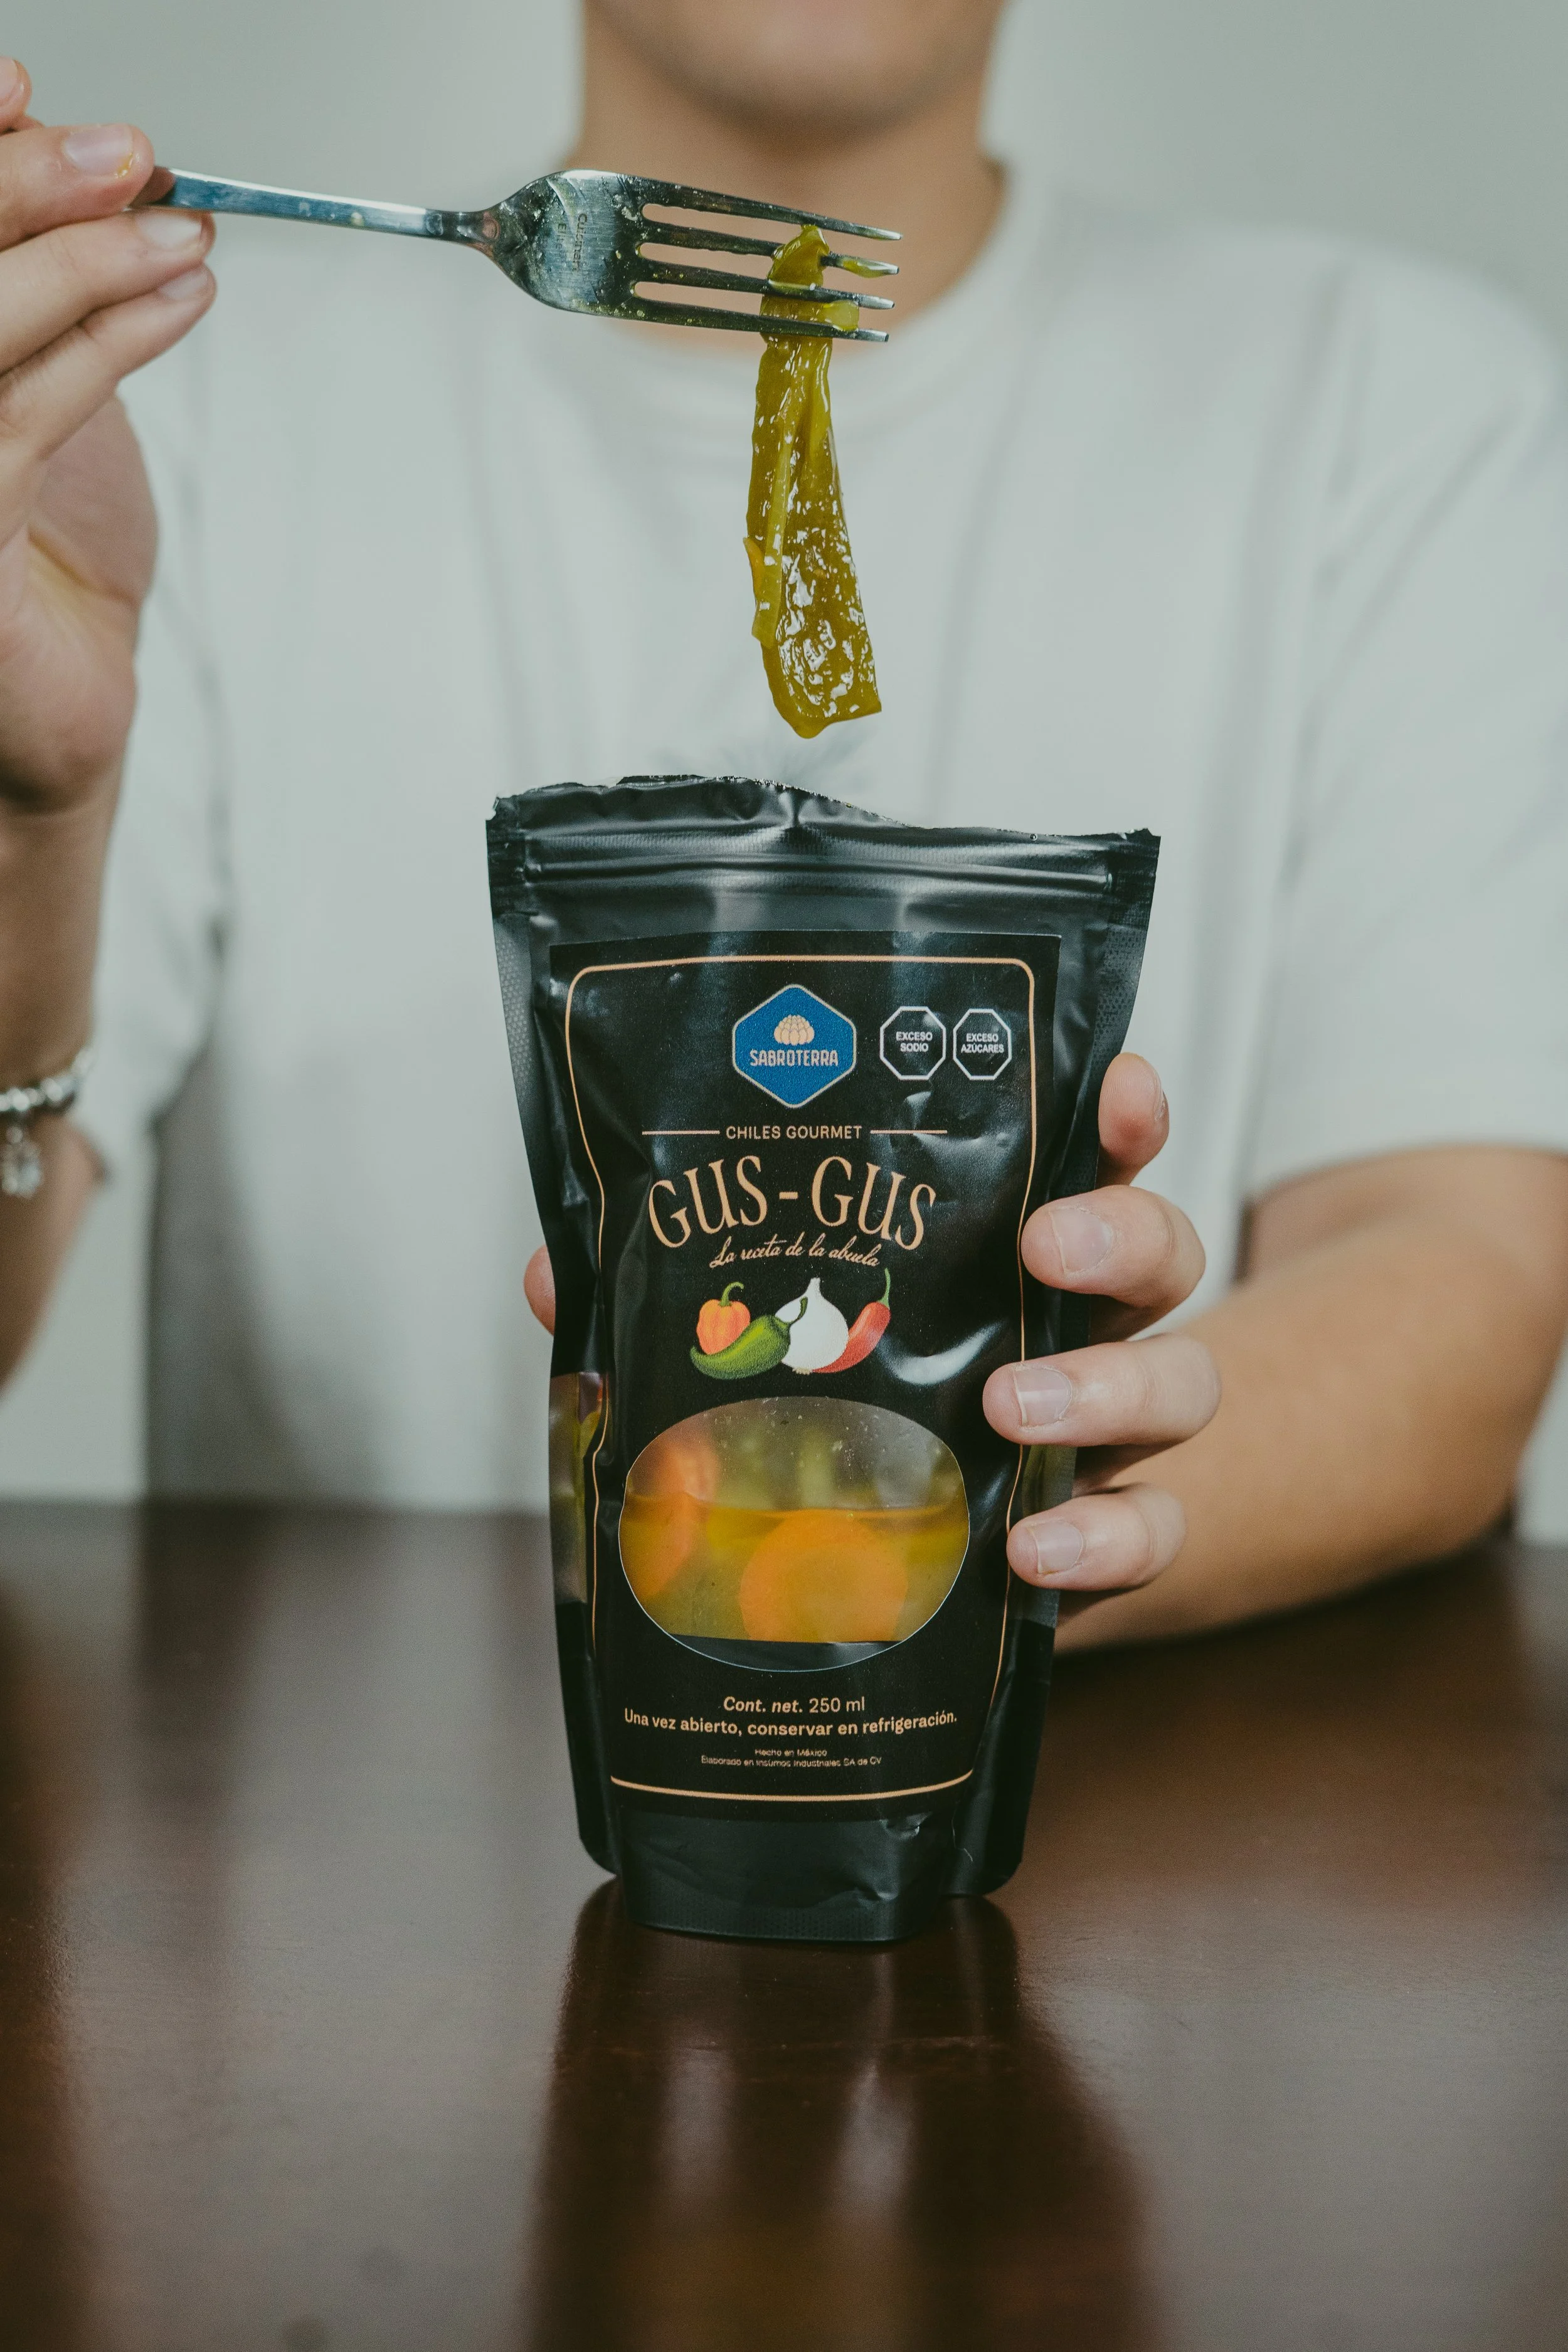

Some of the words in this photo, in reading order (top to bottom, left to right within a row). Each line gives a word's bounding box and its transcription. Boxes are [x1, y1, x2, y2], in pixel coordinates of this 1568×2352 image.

[896, 1031, 933, 1041] EXCESO
[966, 1033, 999, 1042] EXCESO
[900, 1042, 929, 1052] SODIO
[961, 1042, 1004, 1053] AZÚCARES
[750, 1049, 839, 1066] SABROTERRA
[726, 1126, 781, 1140] CHILES
[787, 1125, 863, 1140] GOURMET
[709, 1236, 736, 1268] La
[741, 1234, 787, 1260] receta
[785, 1231, 805, 1256] de
[809, 1232, 825, 1256] la
[829, 1236, 881, 1267] abuela
[724, 1696, 766, 1712] Cont.
[771, 1698, 803, 1713] net.
[809, 1697, 840, 1714] 250
[846, 1696, 865, 1712] ml
[625, 1708, 649, 1726] Una
[652, 1717, 676, 1729] vez
[681, 1717, 743, 1737] abierto,
[748, 1724, 833, 1735] conservar
[838, 1724, 858, 1735] en
[862, 1710, 957, 1735] refrigeración.
[701, 1754, 741, 1766] Elaborado
[857, 1757, 868, 1766] de
